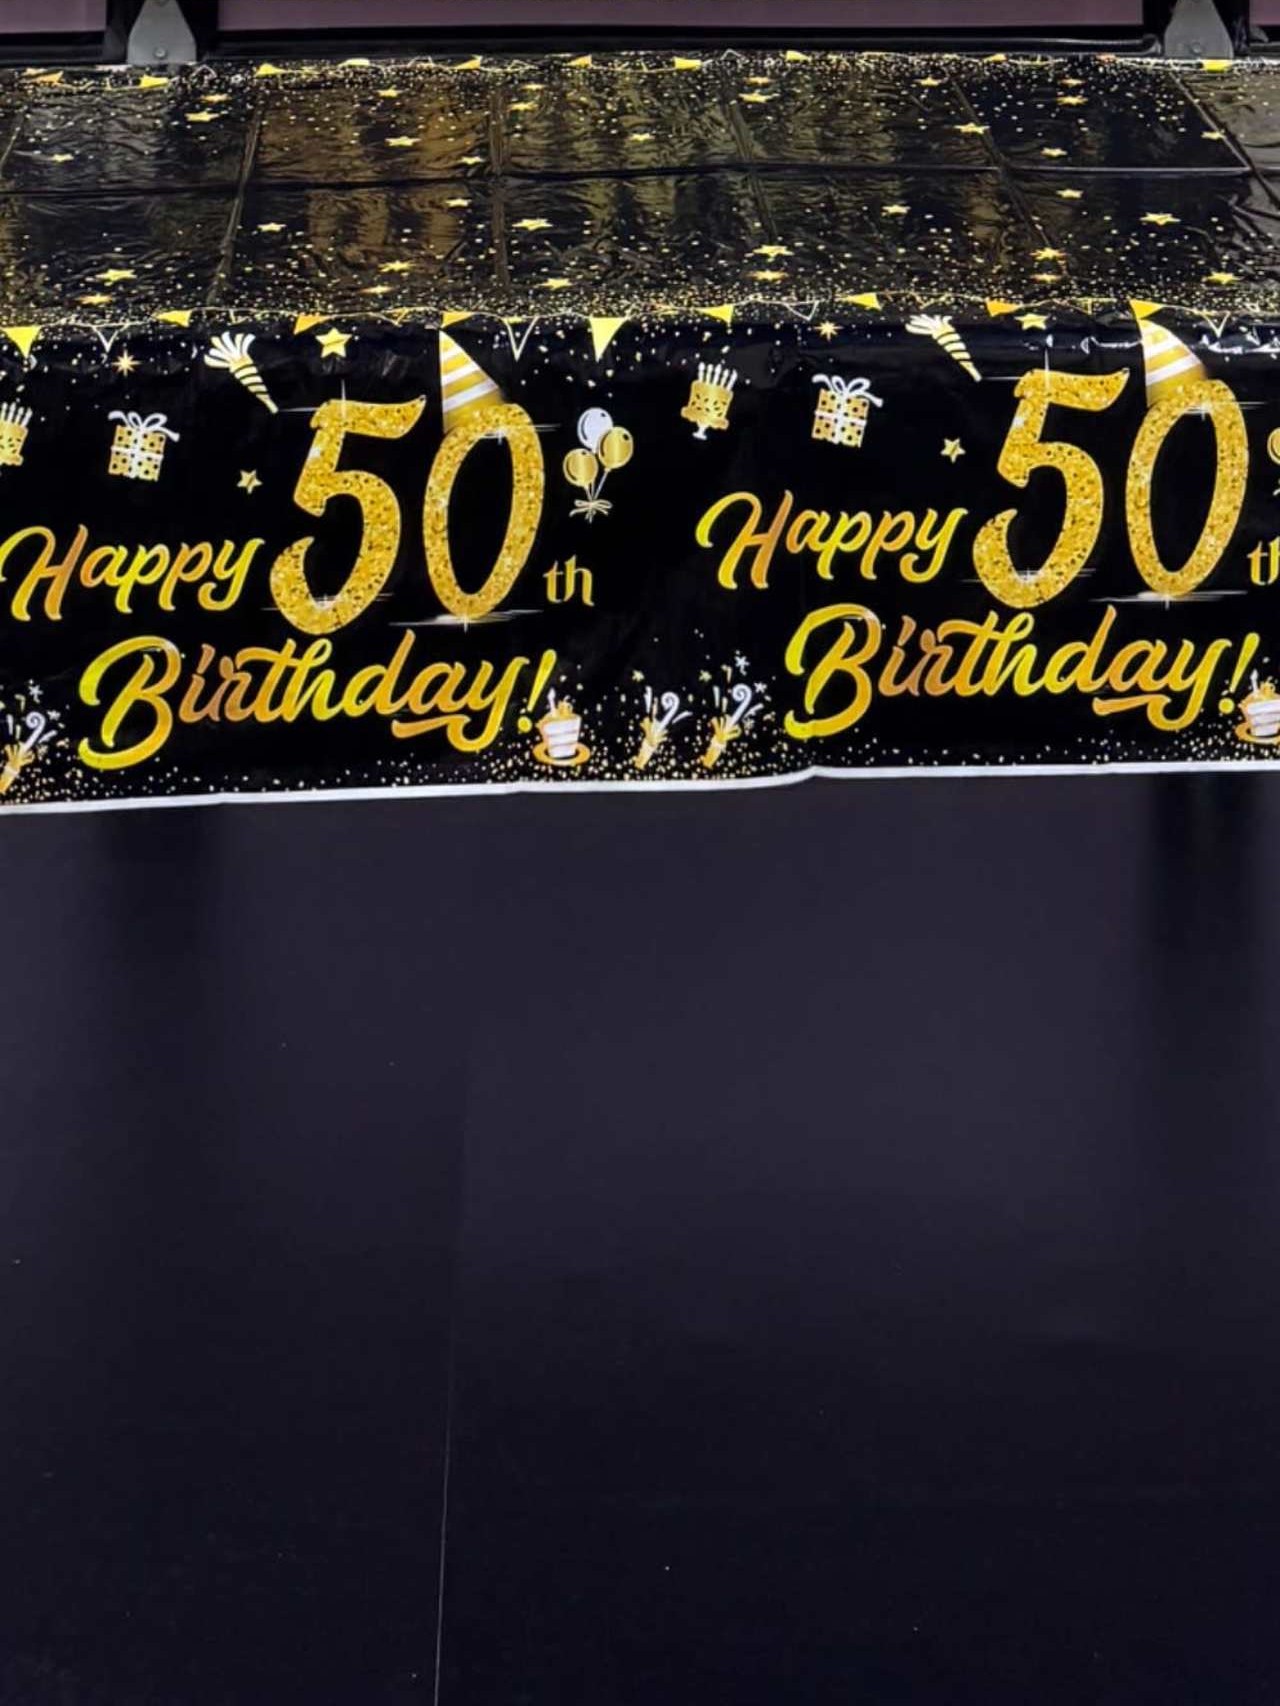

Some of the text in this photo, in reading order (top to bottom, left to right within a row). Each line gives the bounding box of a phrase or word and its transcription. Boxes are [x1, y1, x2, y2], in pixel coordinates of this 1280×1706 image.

[695, 490, 968, 589] Happy
[78, 629, 557, 770] Birthday!
[784, 604, 1260, 739] Birthday!
